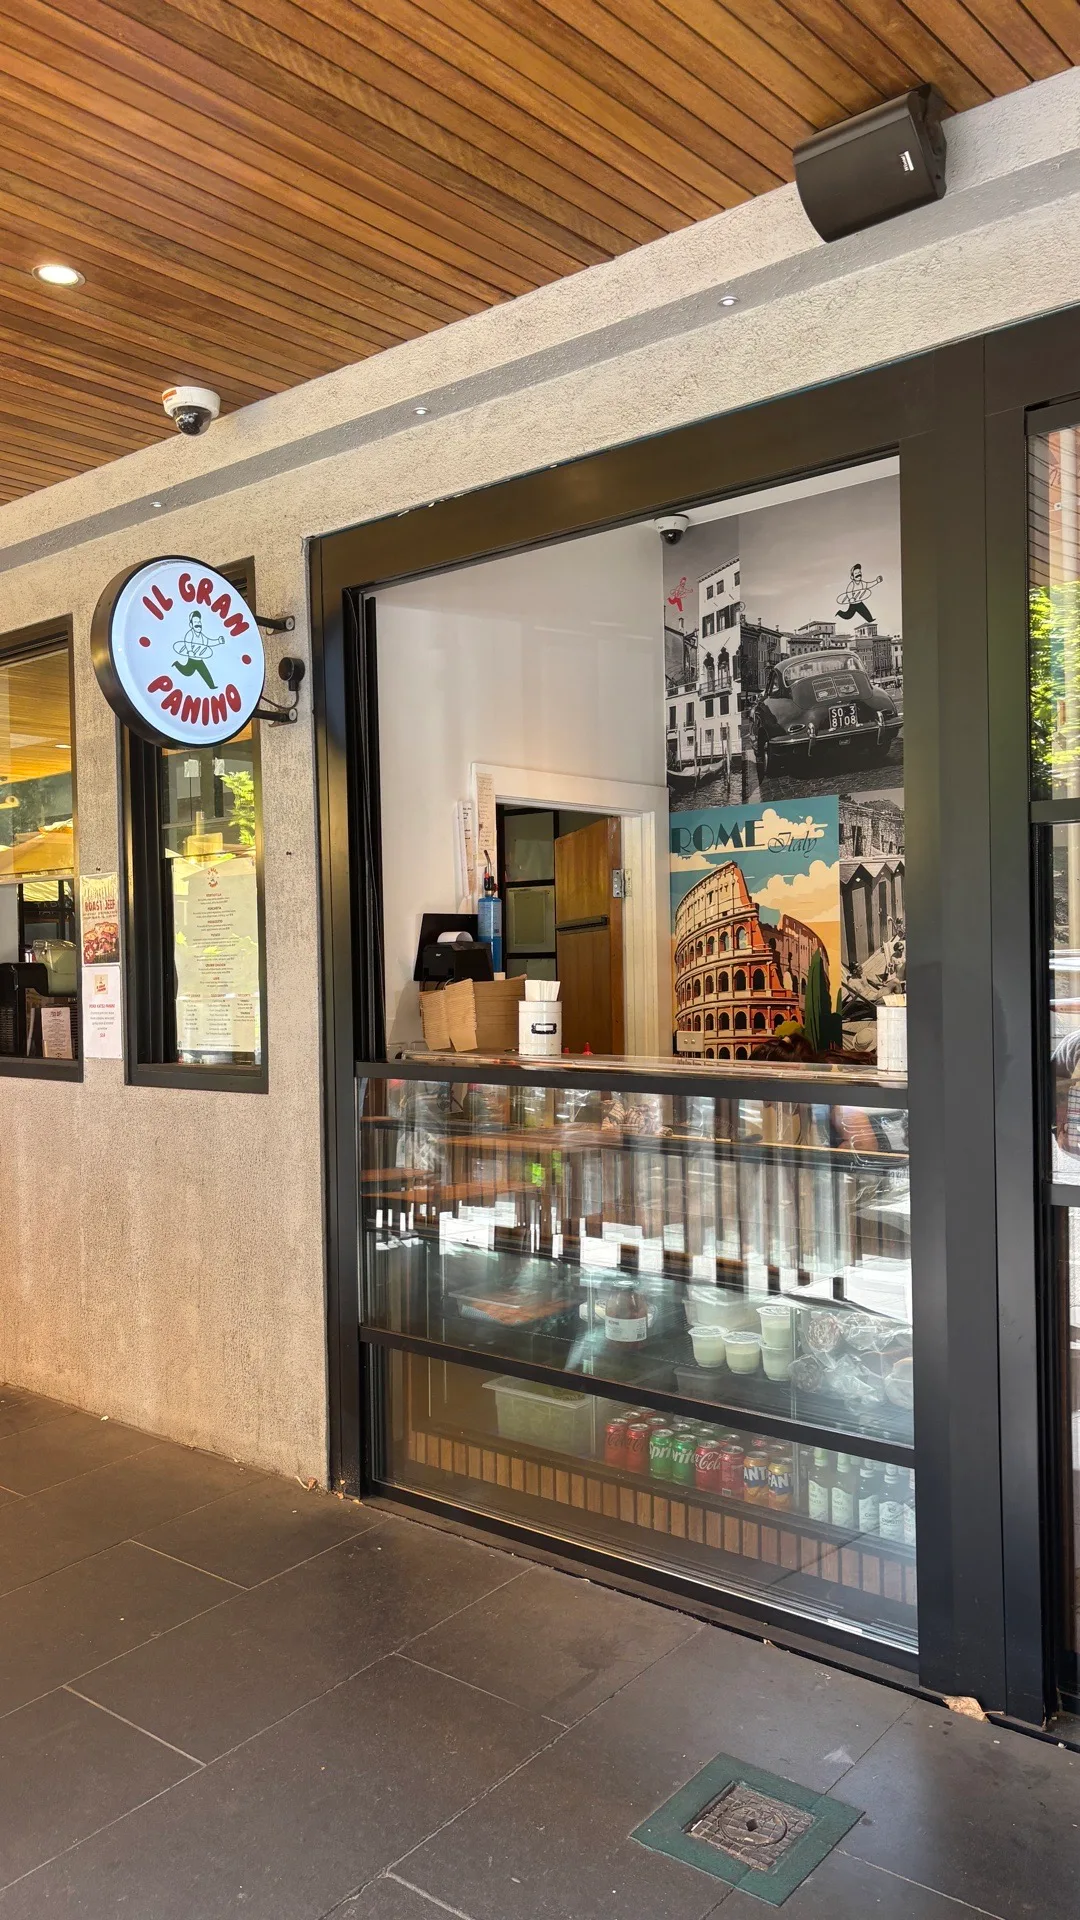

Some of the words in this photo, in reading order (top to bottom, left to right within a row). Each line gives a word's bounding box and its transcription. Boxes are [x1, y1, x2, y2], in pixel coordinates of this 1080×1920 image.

[142, 585, 173, 621] IL
[178, 573, 250, 637] GRAN
[147, 675, 242, 726] PANINO
[832, 708, 844, 718] SO
[850, 705, 855, 715] 3
[832, 715, 855, 728] 8108
[671, 820, 764, 853] ROME
[767, 831, 818, 858] Italy
